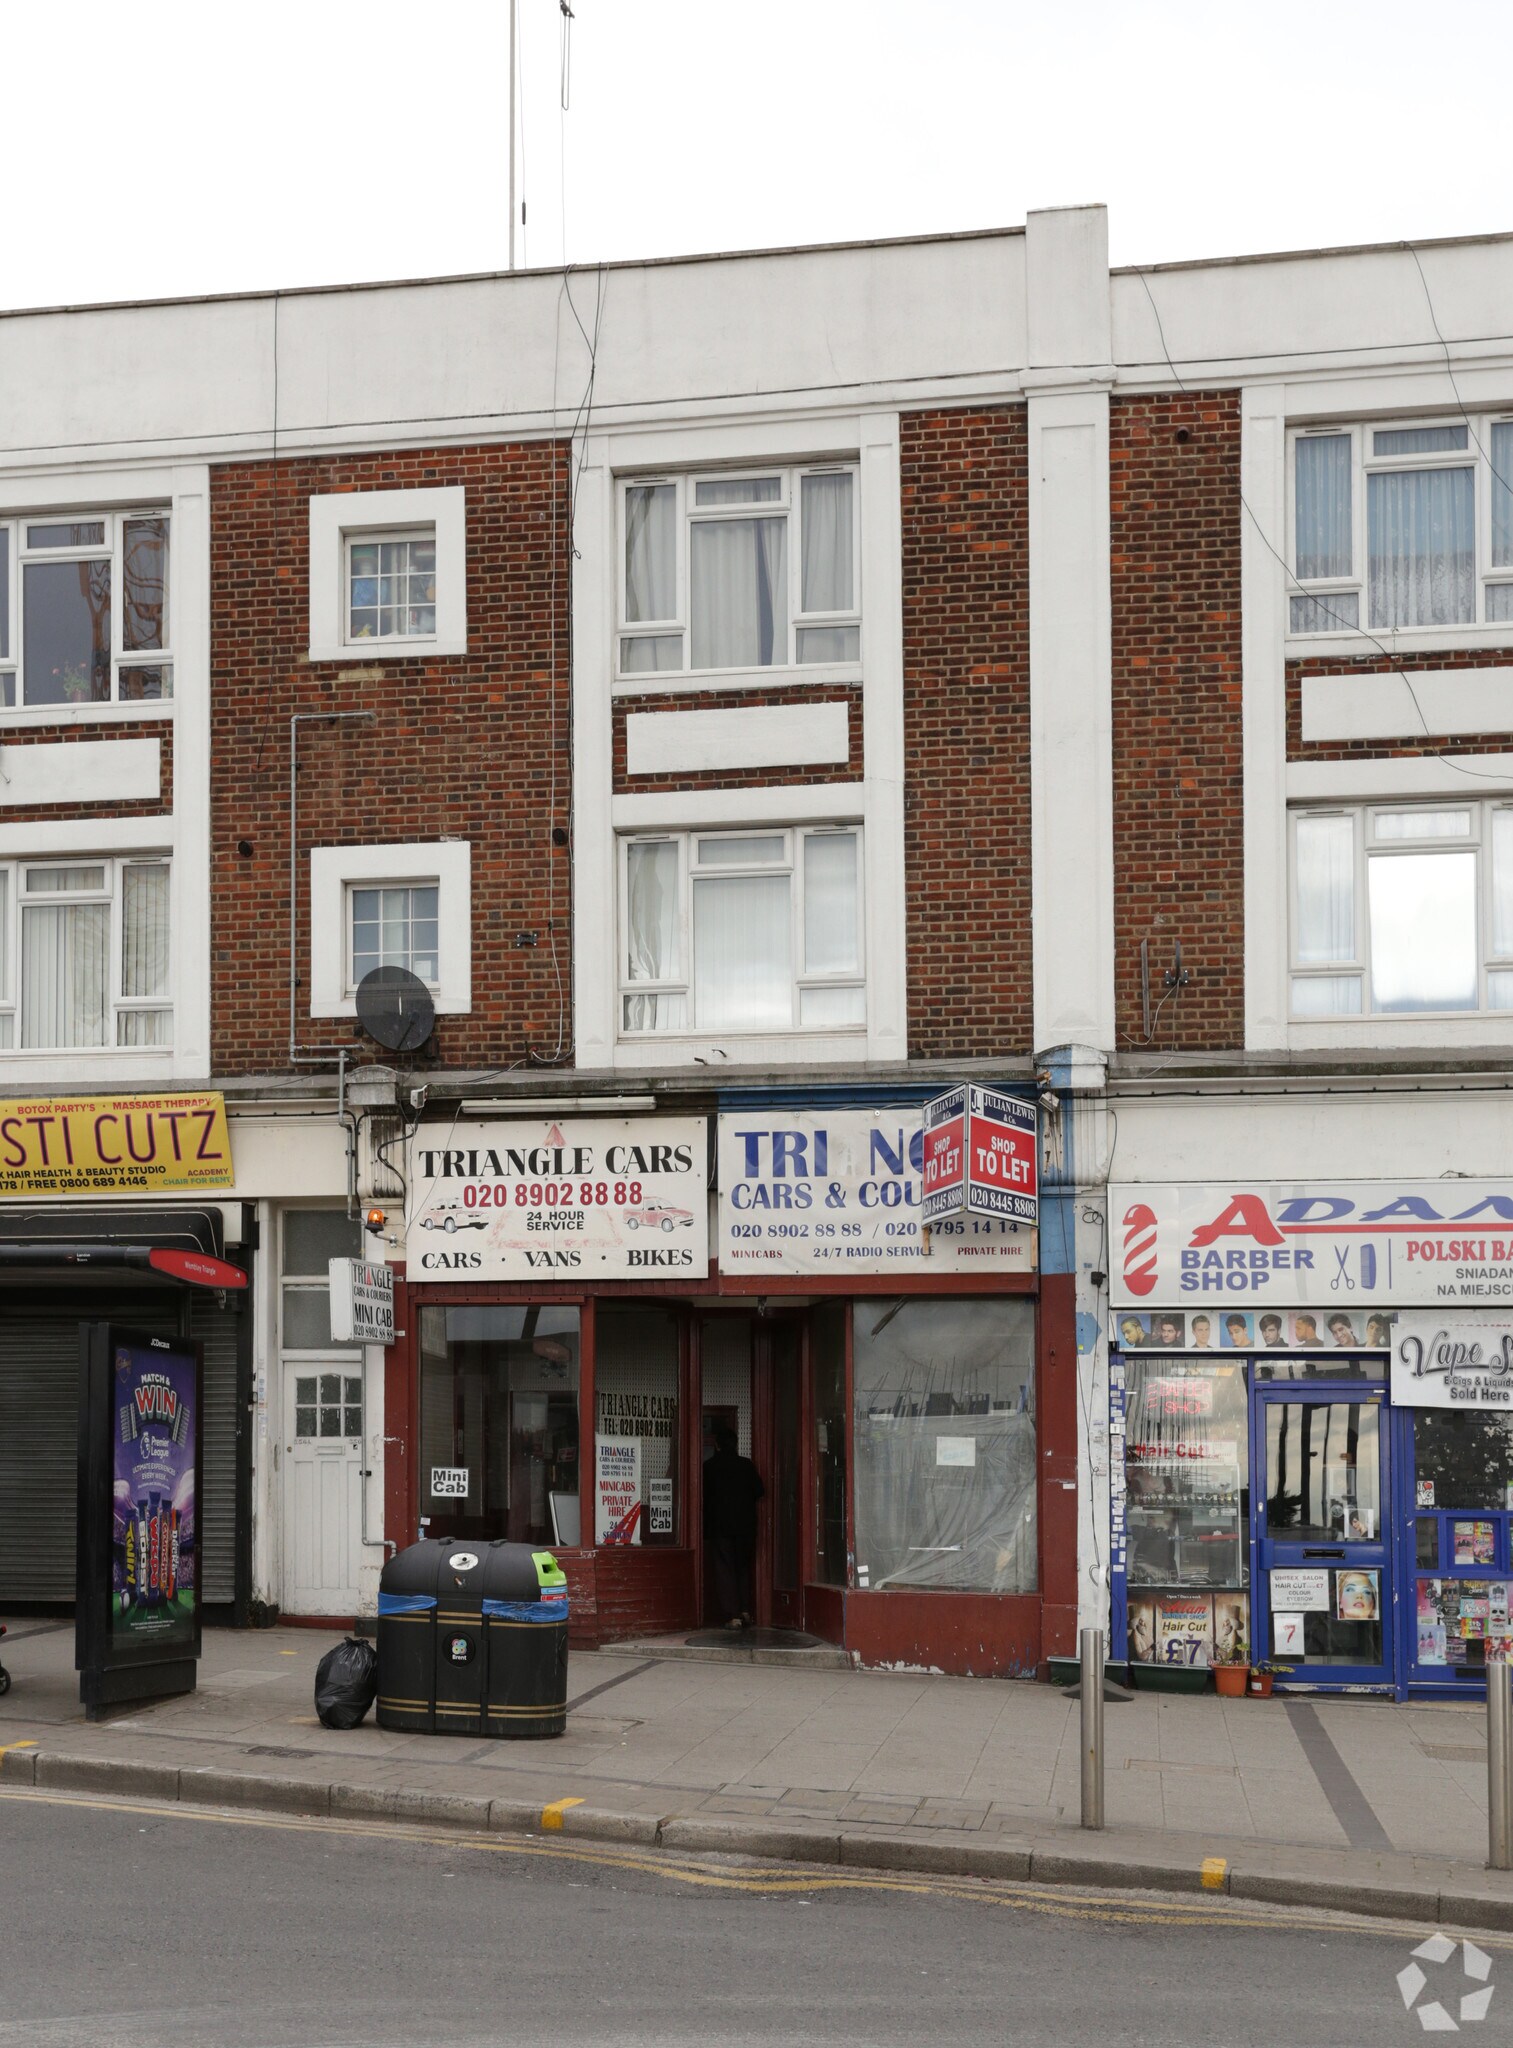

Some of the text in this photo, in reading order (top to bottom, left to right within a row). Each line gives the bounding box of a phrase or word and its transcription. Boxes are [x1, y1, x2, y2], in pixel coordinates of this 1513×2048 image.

[17, 1103, 96, 1114] BOTOX PARTY'S
[113, 1098, 211, 1110] MASSAGE THERAPY
[931, 1091, 965, 1117] JULIAN LEWIS
[984, 1094, 1035, 1121] JULIAN LEWIS
[1003, 1114, 1017, 1125] & Co.
[94, 1110, 223, 1165] CUTZ
[934, 1136, 951, 1156] SHOP
[991, 1136, 1016, 1155] SHOP
[418, 1144, 693, 1178] TRIANGLE CARS
[926, 1147, 960, 1184] TO LET
[977, 1147, 1030, 1184] TO LET
[6, 1165, 166, 1179] HAIR HEALTH & BEAUTY STUDIO
[188, 1168, 229, 1176] ACADEMY
[27, 1178, 58, 1189] FREE
[59, 1177, 90, 1188] 0800
[93, 1176, 116, 1187] 689
[118, 1175, 148, 1186] 4146
[162, 1176, 231, 1186] CHAIR FOR RENT
[463, 1181, 643, 1208] 020 8902 88 88
[731, 1183, 813, 1209] CARS
[824, 1182, 847, 1209] &
[932, 1194, 947, 1213] 8445
[947, 1187, 963, 1208] 8808
[971, 1187, 1036, 1218] 020 8445 8808
[527, 1211, 584, 1221] 24 HOUR
[527, 1221, 584, 1231] SERVICE
[731, 1224, 762, 1238] 020
[767, 1224, 809, 1238] 8902
[815, 1223, 836, 1237] 88
[841, 1223, 862, 1237] 88
[885, 1222, 917, 1236] 020
[972, 1220, 992, 1234] 14
[999, 1220, 1019, 1233] 14
[731, 1250, 783, 1259] MINICABS
[813, 1246, 842, 1260] 24/7
[846, 1247, 883, 1257] RADIO
[957, 1247, 997, 1256] PRIVATE
[1000, 1246, 1024, 1255] HIRE
[1406, 1240, 1486, 1261] POLSKI
[421, 1249, 693, 1269] CARS VANS BIKES
[1181, 1250, 1315, 1269] BARBER
[353, 1263, 392, 1290] TRIANGLE
[1180, 1271, 1270, 1291] SHOP
[353, 1286, 366, 1298] CARS
[1437, 1284, 1513, 1296] NA MIEJSC
[354, 1303, 392, 1328] MINI CAB
[354, 1324, 365, 1336] 020
[1400, 1329, 1482, 1377] Vape
[141, 1373, 165, 1384] MATCH
[1444, 1376, 1472, 1386] E-Cigs
[1474, 1376, 1481, 1386] &
[1160, 1380, 1211, 1397] BARBER
[1450, 1387, 1510, 1401] Sold Here
[134, 1385, 177, 1419] WIN
[601, 1393, 675, 1419] TRIANGLE CARS
[1164, 1400, 1210, 1415] SHOP
[620, 1418, 634, 1436] 020
[635, 1420, 653, 1437] 8902
[152, 1435, 169, 1447] Premier
[151, 1445, 169, 1459] League
[600, 1446, 635, 1457] TRIANGLE
[1136, 1443, 1168, 1457] Hair
[1176, 1443, 1205, 1458] Cut
[433, 1470, 467, 1481] Mini
[433, 1481, 466, 1493] Cab
[600, 1481, 636, 1492] MINICABS
[602, 1495, 632, 1507] PRIVATE
[608, 1506, 626, 1517] HIRE
[651, 1507, 671, 1517] Mini
[651, 1518, 671, 1529] Cab
[1160, 1600, 1208, 1614] Adam
[1162, 1621, 1207, 1631] Hair Cut
[1166, 1638, 1202, 1664] £7
